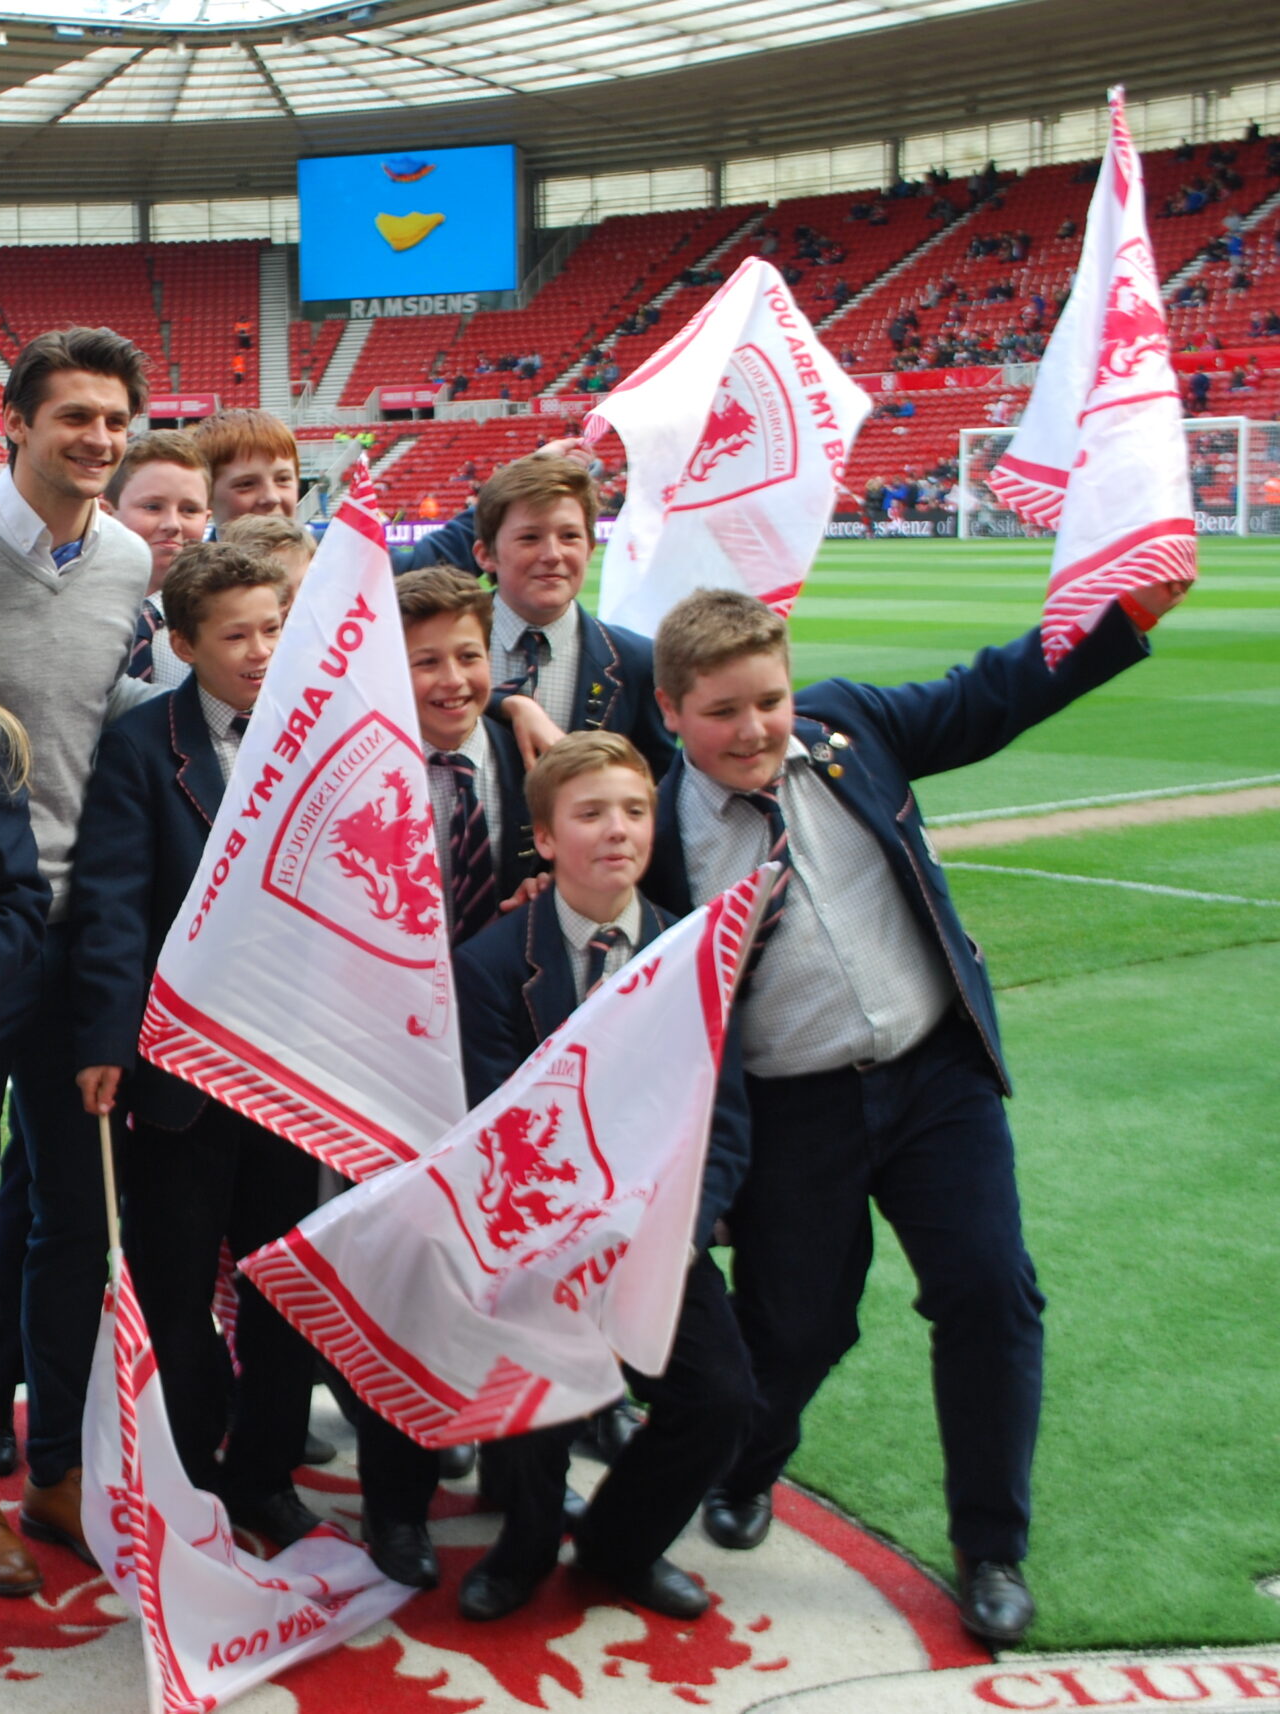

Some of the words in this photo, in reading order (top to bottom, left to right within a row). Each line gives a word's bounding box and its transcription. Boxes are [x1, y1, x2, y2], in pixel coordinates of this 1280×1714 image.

[350, 294, 478, 319] RAMSDENS
[764, 284, 797, 330] YOU
[785, 336, 821, 387] ARE
[806, 391, 839, 432] MY
[738, 351, 786, 471] MIDDLESBROUGH
[936, 516, 956, 535] of
[973, 1662, 1280, 1710] CLUB
